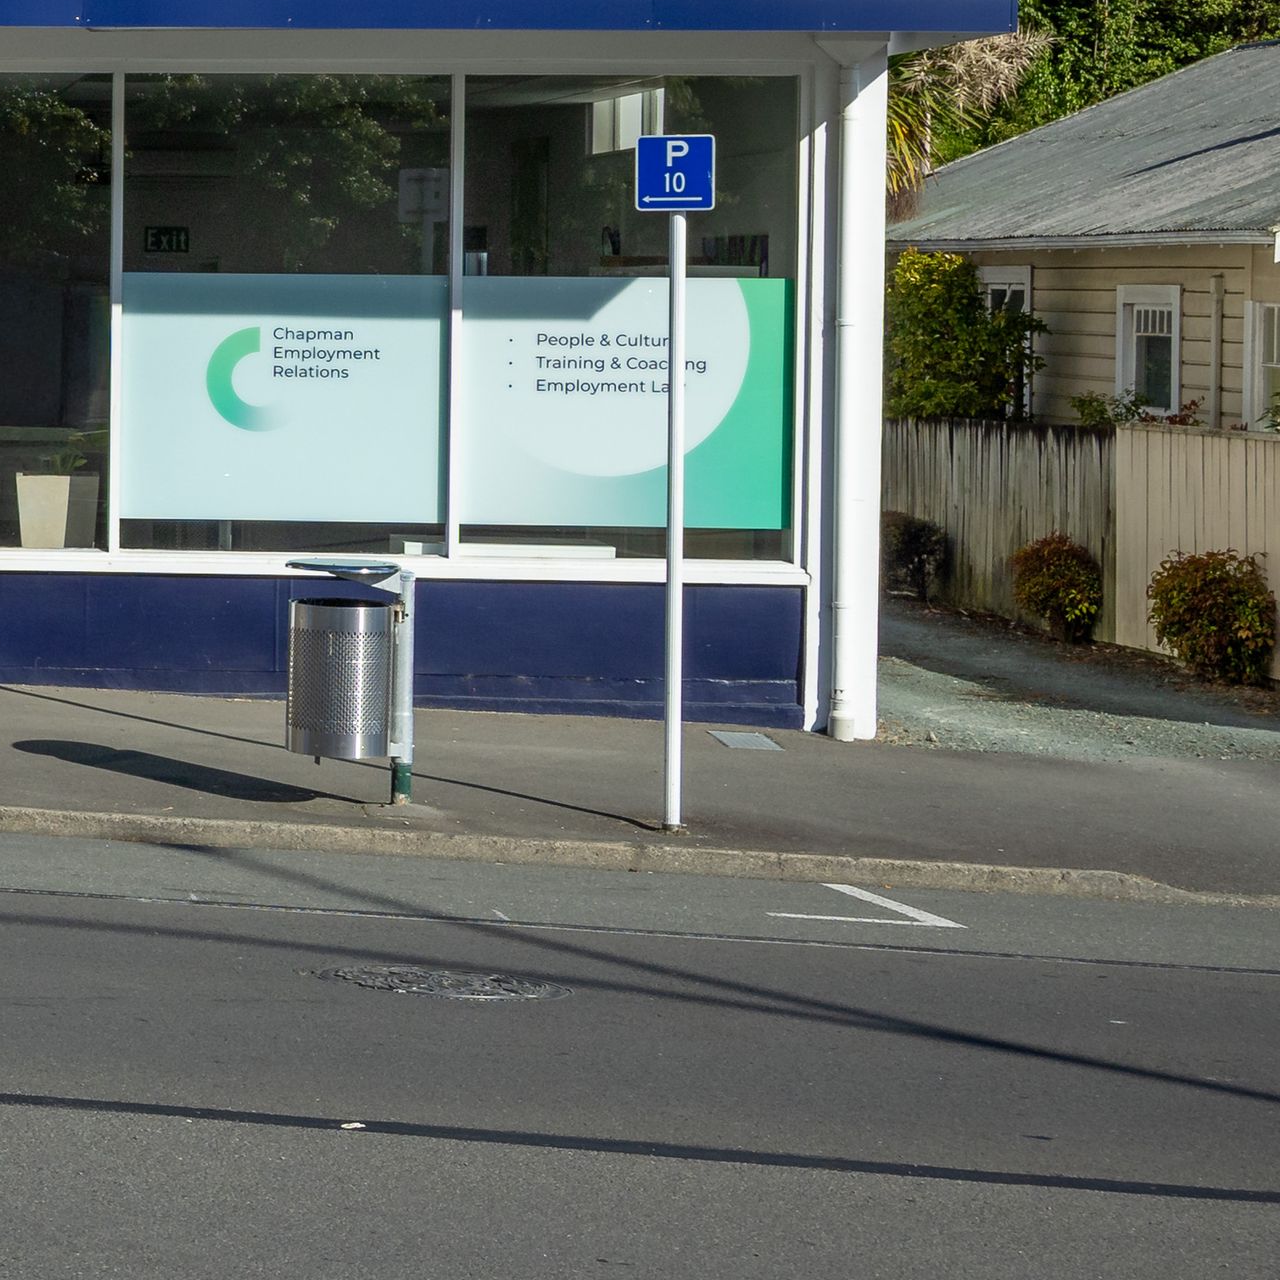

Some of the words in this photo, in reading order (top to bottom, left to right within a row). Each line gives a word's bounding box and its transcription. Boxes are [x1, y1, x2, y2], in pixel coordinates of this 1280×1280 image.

[666, 140, 689, 167] P
[664, 172, 686, 193] 10
[147, 229, 187, 250] Exit
[273, 327, 354, 343] Chapman
[537, 333, 595, 349] People
[599, 334, 611, 347] &
[615, 334, 670, 347] Cultur
[273, 346, 381, 363] Employment
[273, 365, 349, 379] Relations
[536, 356, 605, 372] Training
[610, 357, 622, 370] &
[626, 357, 707, 374] Coacng
[536, 379, 646, 395] Employment
